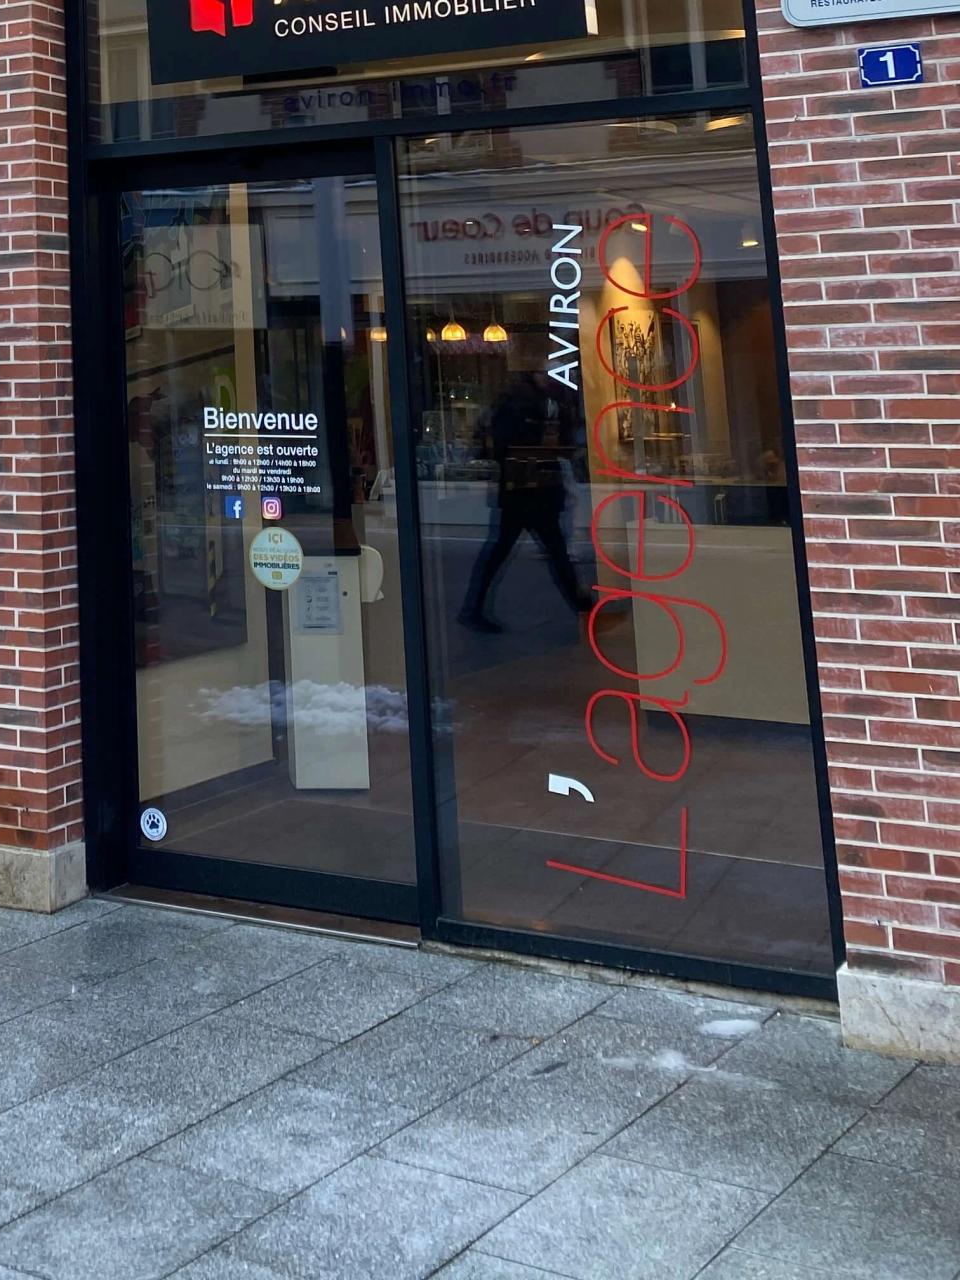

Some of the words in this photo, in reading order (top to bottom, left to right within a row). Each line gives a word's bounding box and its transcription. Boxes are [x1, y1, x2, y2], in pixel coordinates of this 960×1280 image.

[273, 8, 376, 38] CONSEIL
[878, 51, 897, 79] 1
[547, 223, 583, 391] AVIRON
[203, 406, 318, 431] Bienvenue
[206, 442, 254, 457] L'agence
[257, 444, 274, 455] est
[276, 445, 318, 456] ouverte
